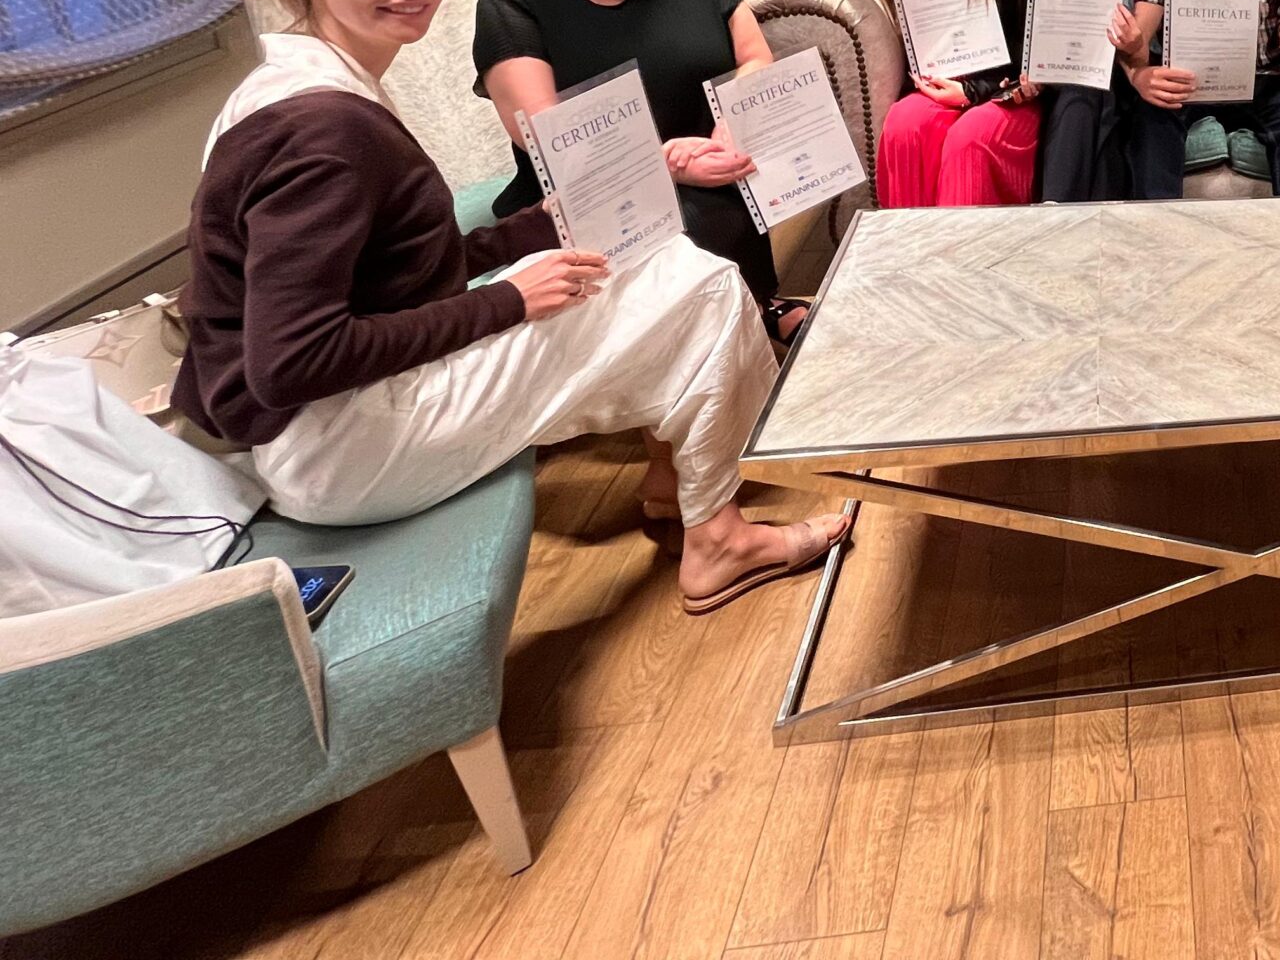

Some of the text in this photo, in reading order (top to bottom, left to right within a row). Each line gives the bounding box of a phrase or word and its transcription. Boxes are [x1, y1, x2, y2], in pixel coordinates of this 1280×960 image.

[1177, 7, 1251, 20] CERTIFICATE
[936, 45, 1001, 67] TRAINING EUROPE
[1046, 63, 1080, 72] TRAINING
[731, 70, 820, 116] CERTIFICATE
[551, 97, 642, 153] CERTIFICATE
[780, 163, 854, 203] TRAINING EUROPE
[643, 210, 674, 237] EUROPE
